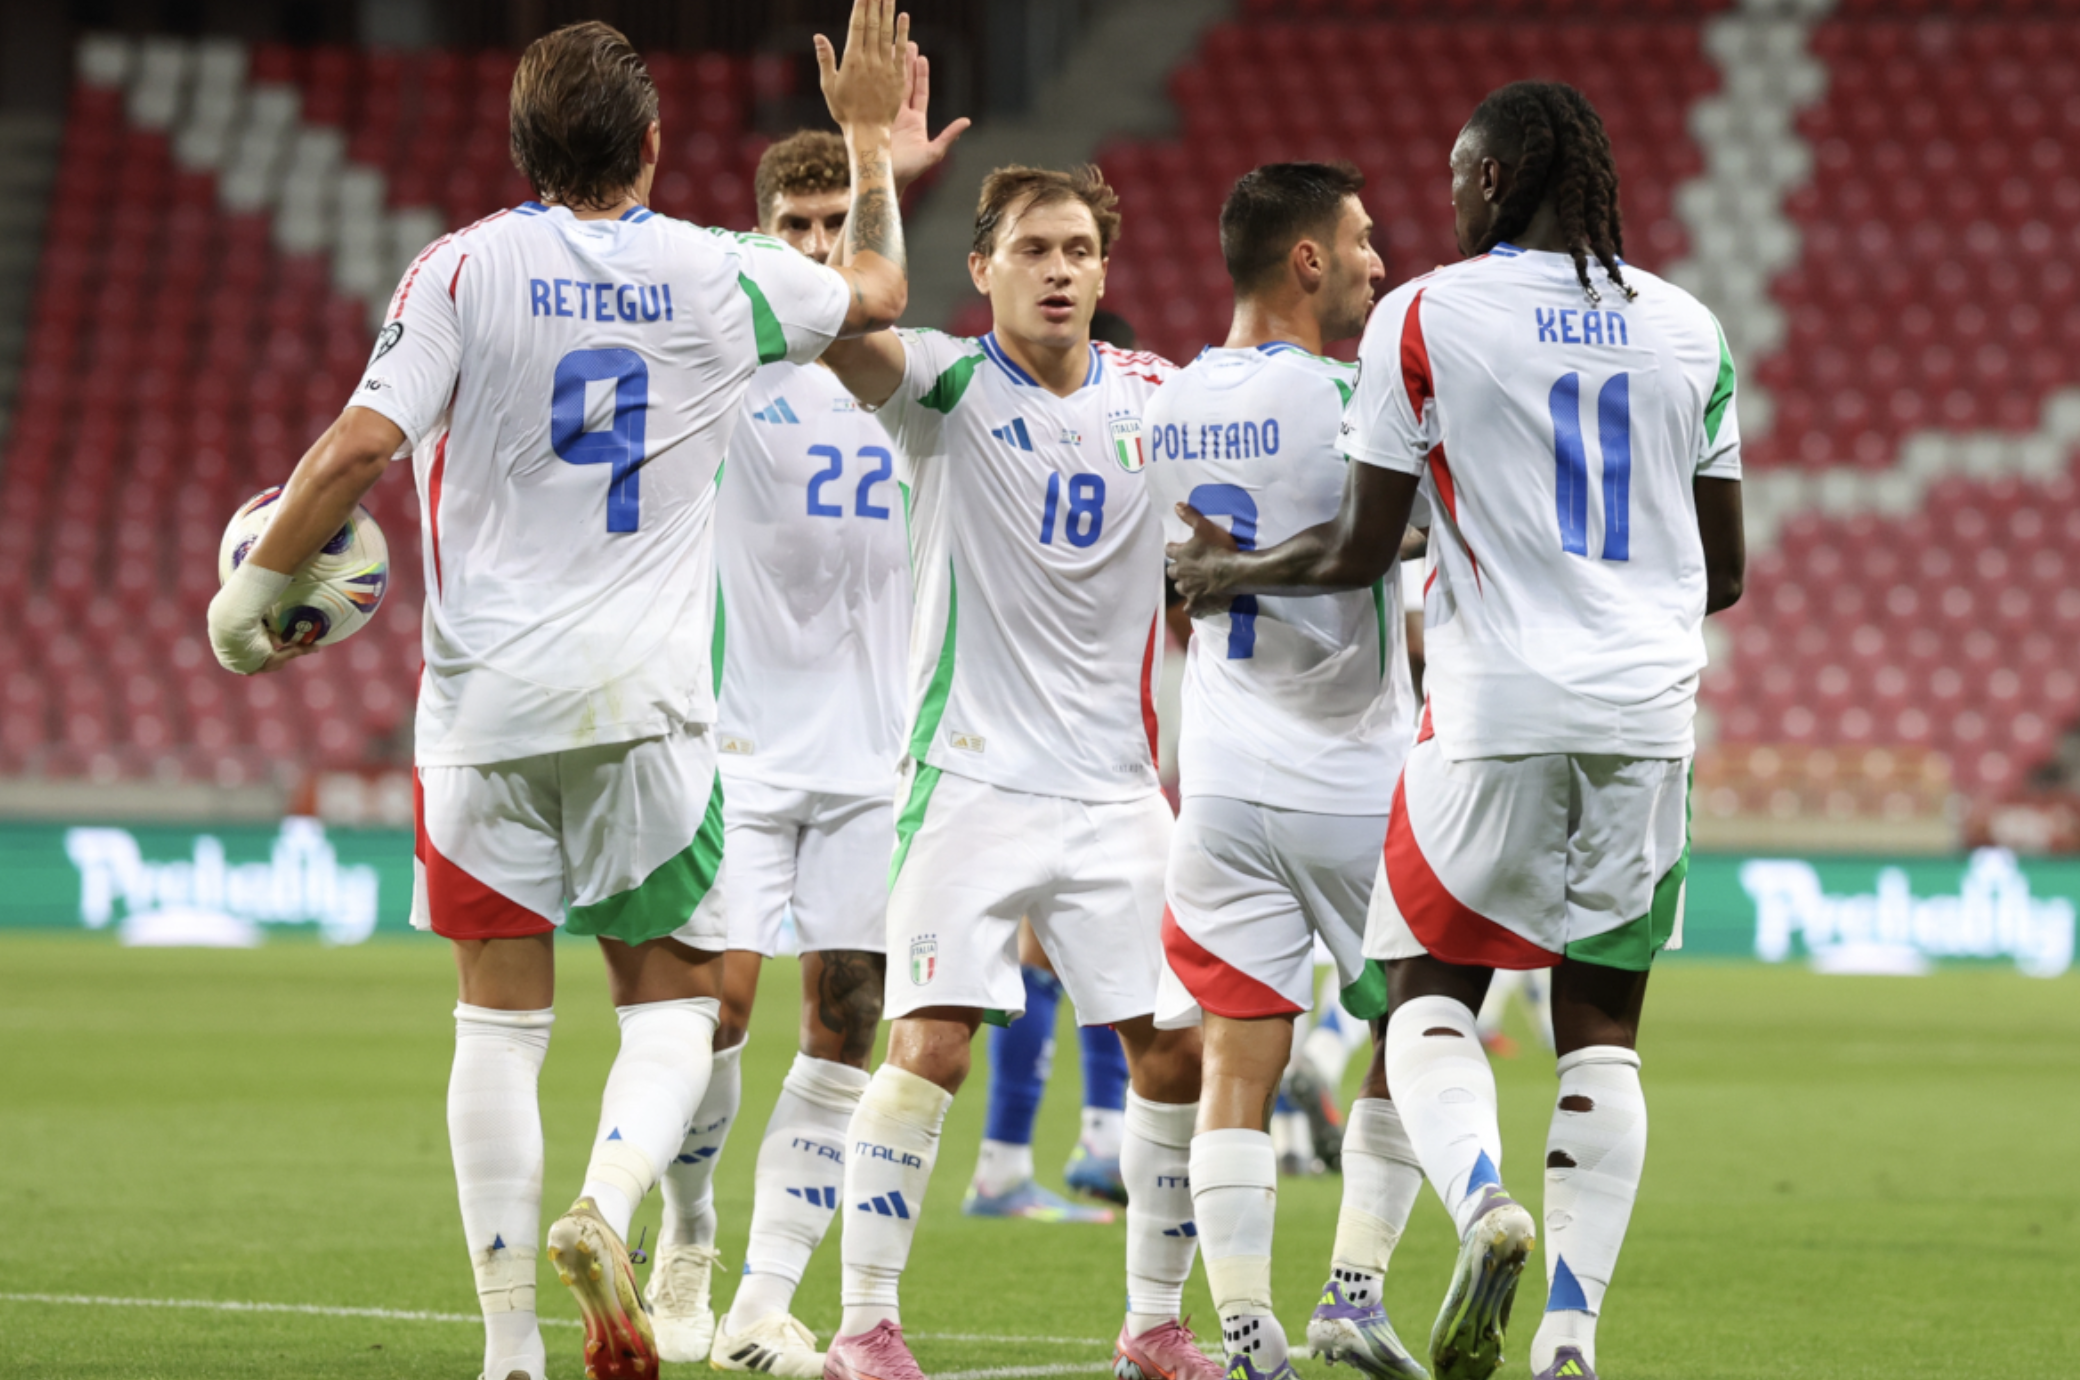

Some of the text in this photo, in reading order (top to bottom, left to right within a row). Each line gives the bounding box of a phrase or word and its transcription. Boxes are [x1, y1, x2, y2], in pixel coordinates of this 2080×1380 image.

[530, 278, 674, 323] RETEGUI
[1535, 307, 1629, 346] KEAN
[551, 348, 649, 533] 9
[1152, 417, 1280, 462] POLITANO
[1549, 371, 1632, 562] 11
[806, 444, 894, 521] 22
[1039, 471, 1107, 549] 18
[855, 1141, 922, 1170] ITALIA
